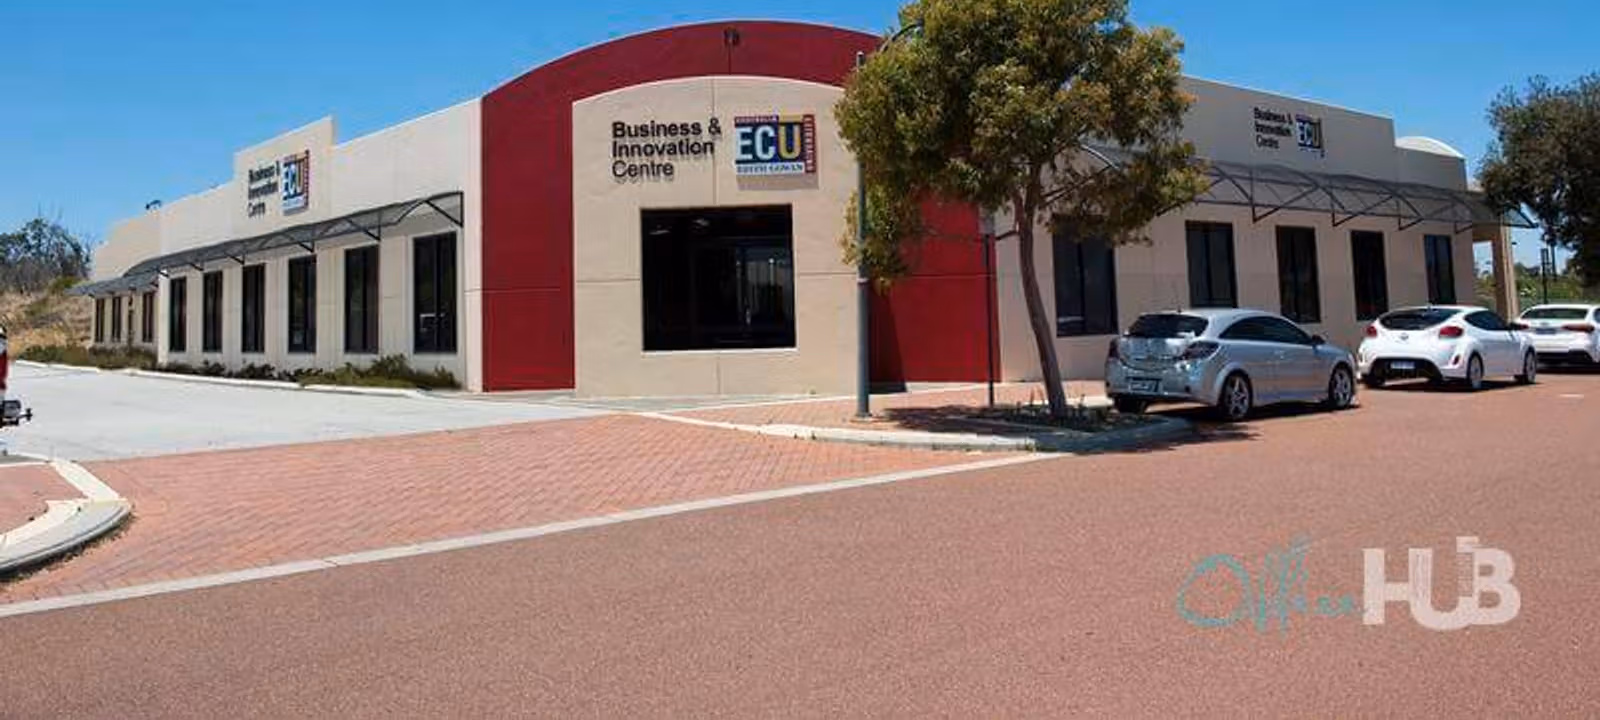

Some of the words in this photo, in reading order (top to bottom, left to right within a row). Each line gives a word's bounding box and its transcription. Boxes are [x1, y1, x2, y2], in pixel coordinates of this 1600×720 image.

[612, 120, 703, 139] Business
[708, 117, 722, 135] &
[1296, 121, 1321, 148] ECU
[612, 139, 715, 158] Innovation
[736, 124, 802, 160] ECU
[282, 159, 304, 197] ECU
[612, 160, 675, 178] Centre
